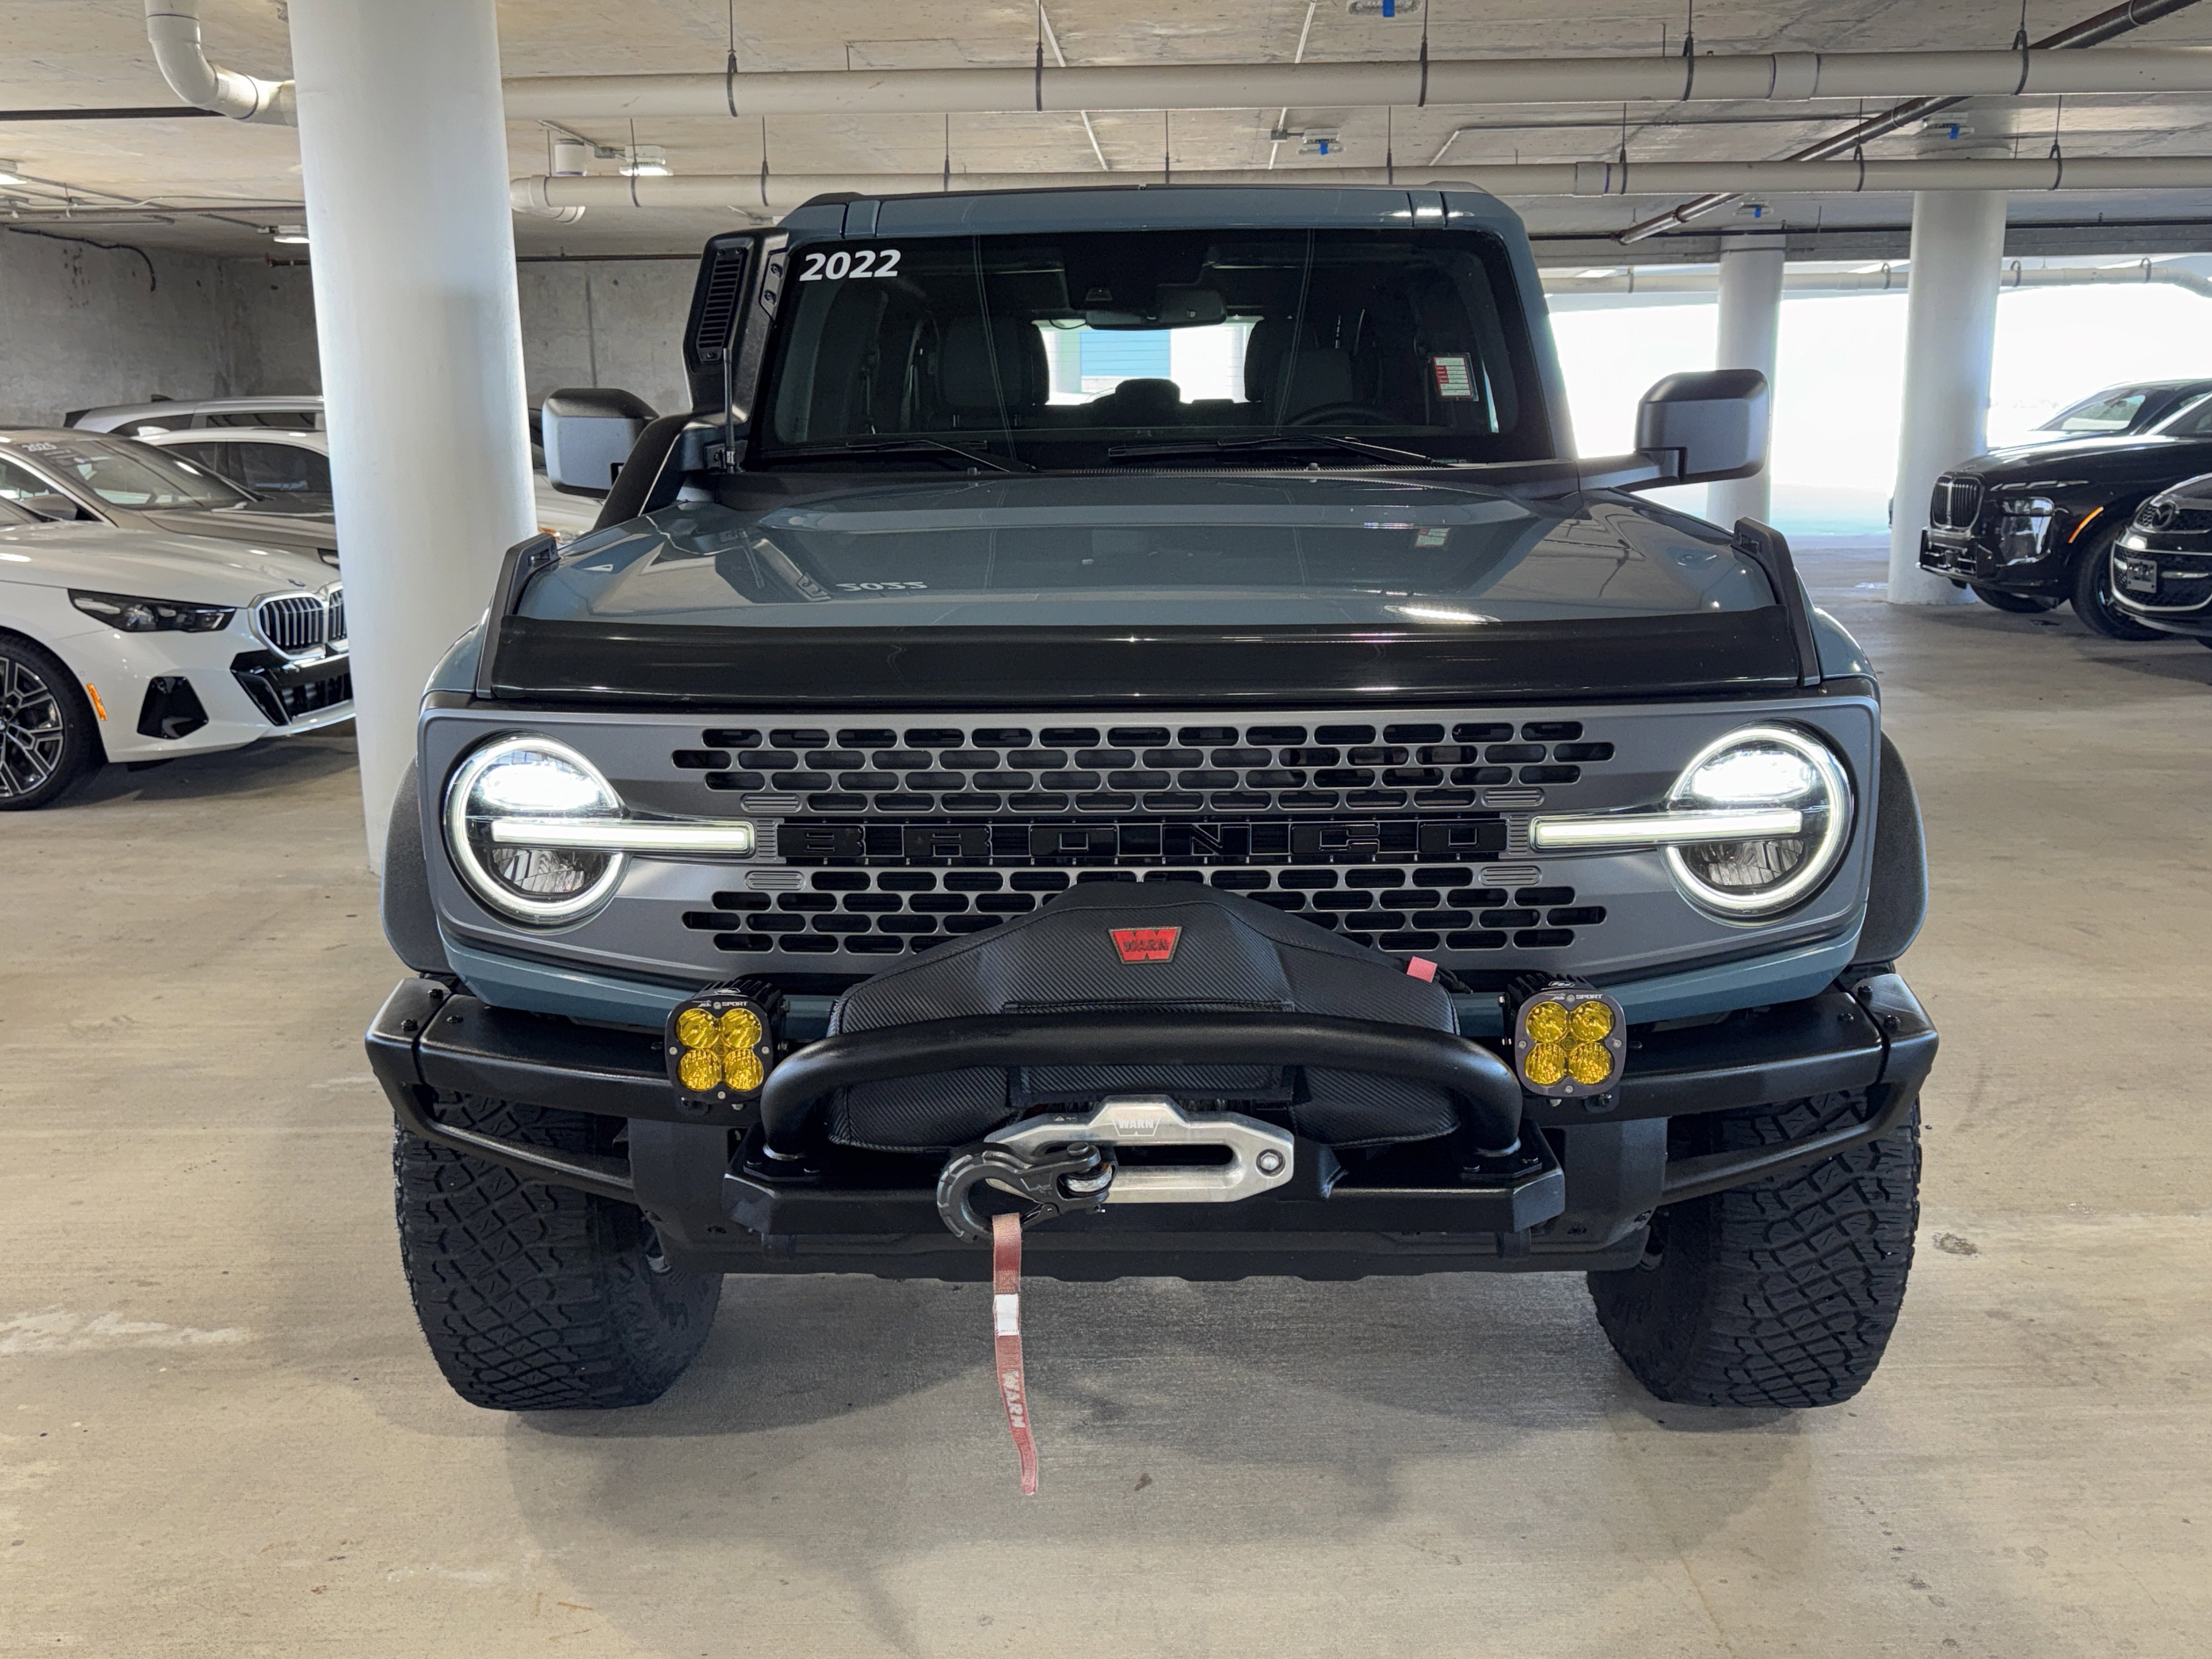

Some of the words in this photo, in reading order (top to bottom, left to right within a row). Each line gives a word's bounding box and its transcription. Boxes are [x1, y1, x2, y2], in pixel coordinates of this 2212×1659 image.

[799, 249, 901, 282] 2022
[776, 819, 1509, 857] BRONCO
[1122, 938, 1169, 952] WARN
[1119, 1119, 1154, 1129] WARN
[1002, 1370, 1026, 1427] WARN
